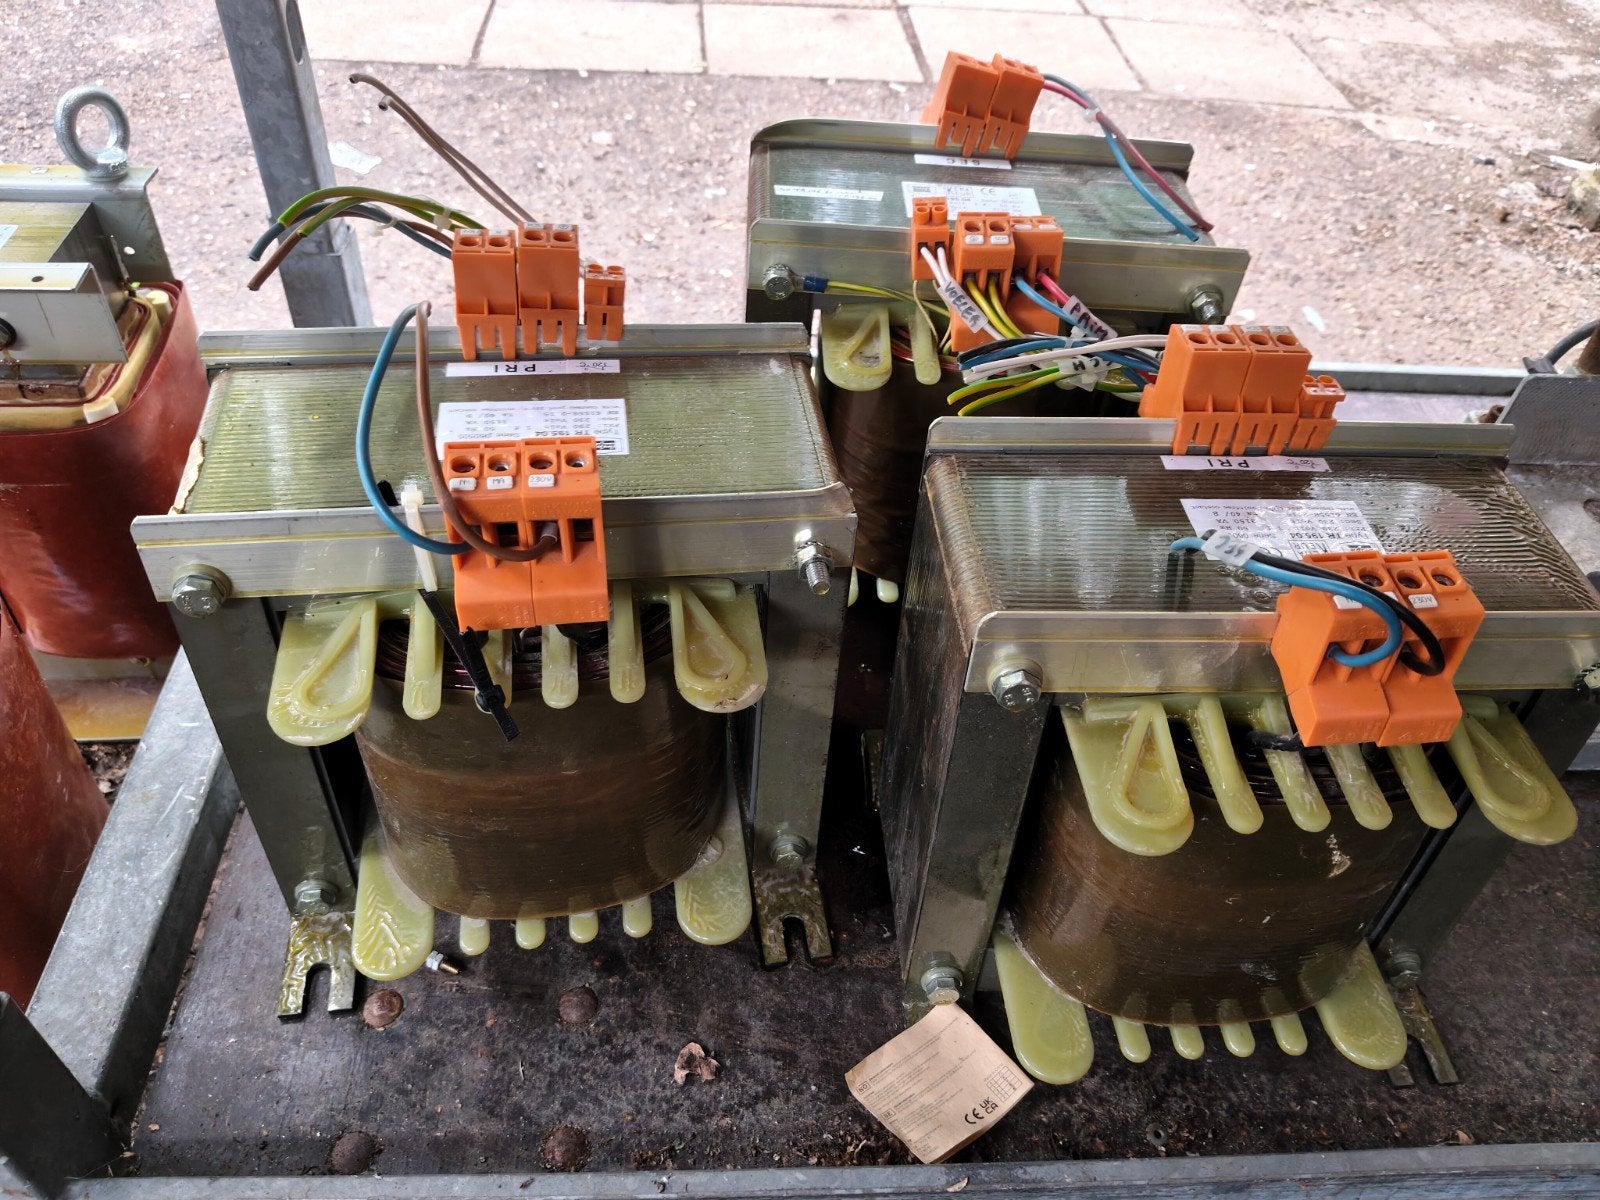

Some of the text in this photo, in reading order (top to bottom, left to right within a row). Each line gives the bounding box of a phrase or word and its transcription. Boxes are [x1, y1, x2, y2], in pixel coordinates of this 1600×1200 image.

[494, 364, 536, 373] PRI
[1206, 458, 1250, 468] PRI
[530, 476, 552, 484] 230V
[1412, 596, 1434, 604] 230V
[979, 1096, 993, 1109] UK
[984, 1102, 998, 1114] CA
[964, 1108, 985, 1125] CE
